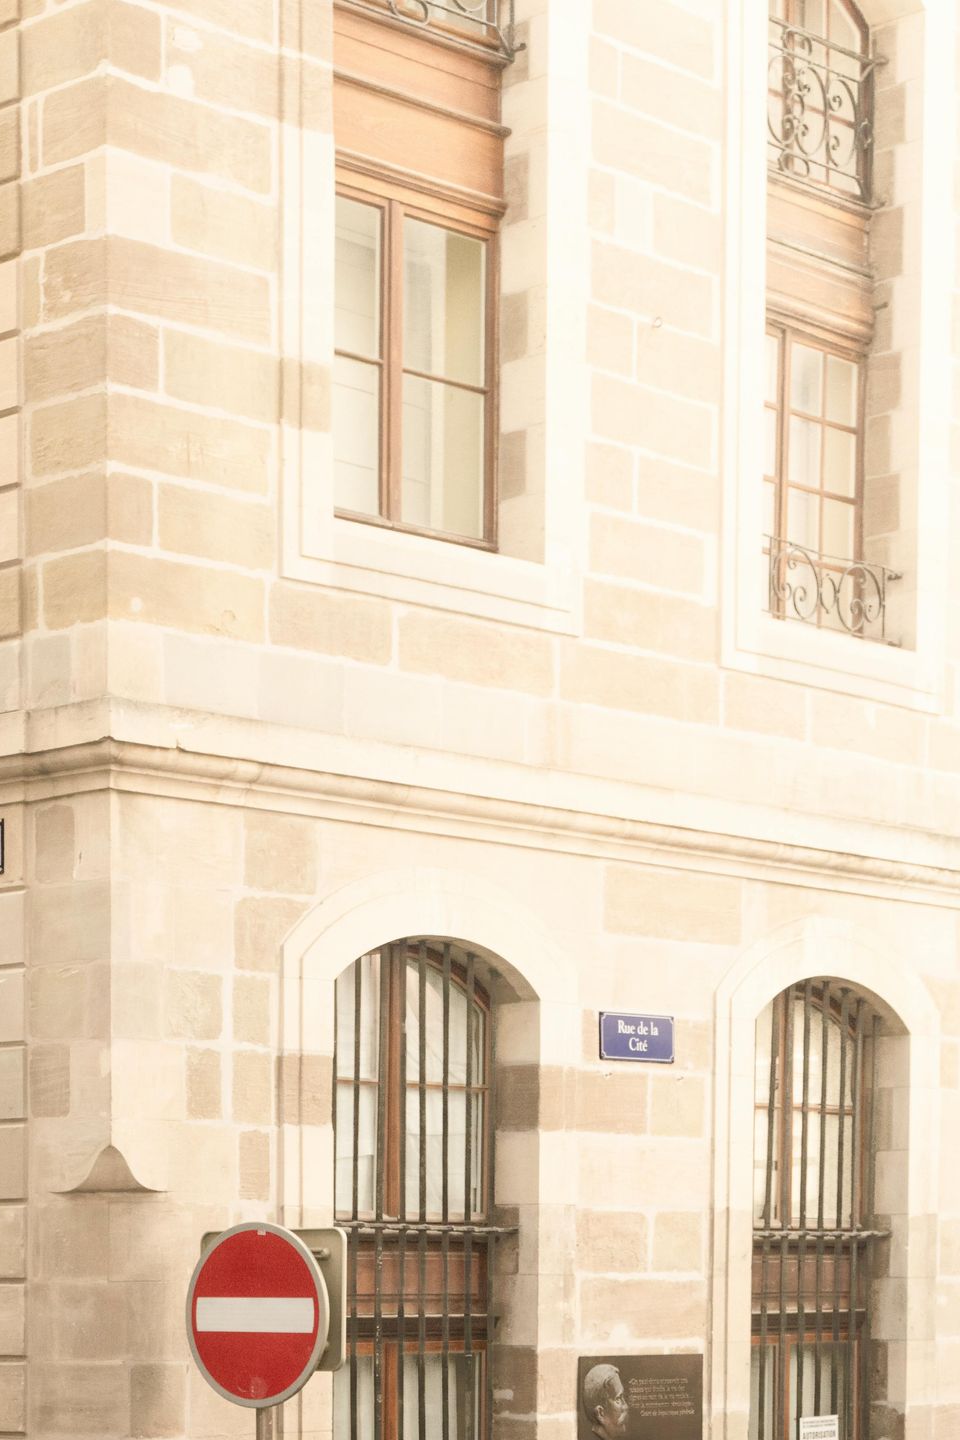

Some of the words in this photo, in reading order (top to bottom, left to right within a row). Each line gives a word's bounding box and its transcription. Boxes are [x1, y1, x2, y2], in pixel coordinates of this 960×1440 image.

[617, 1019, 635, 1034] Rue
[637, 1020, 648, 1035] de
[650, 1021, 659, 1036] la
[628, 1037, 648, 1052] Cité
